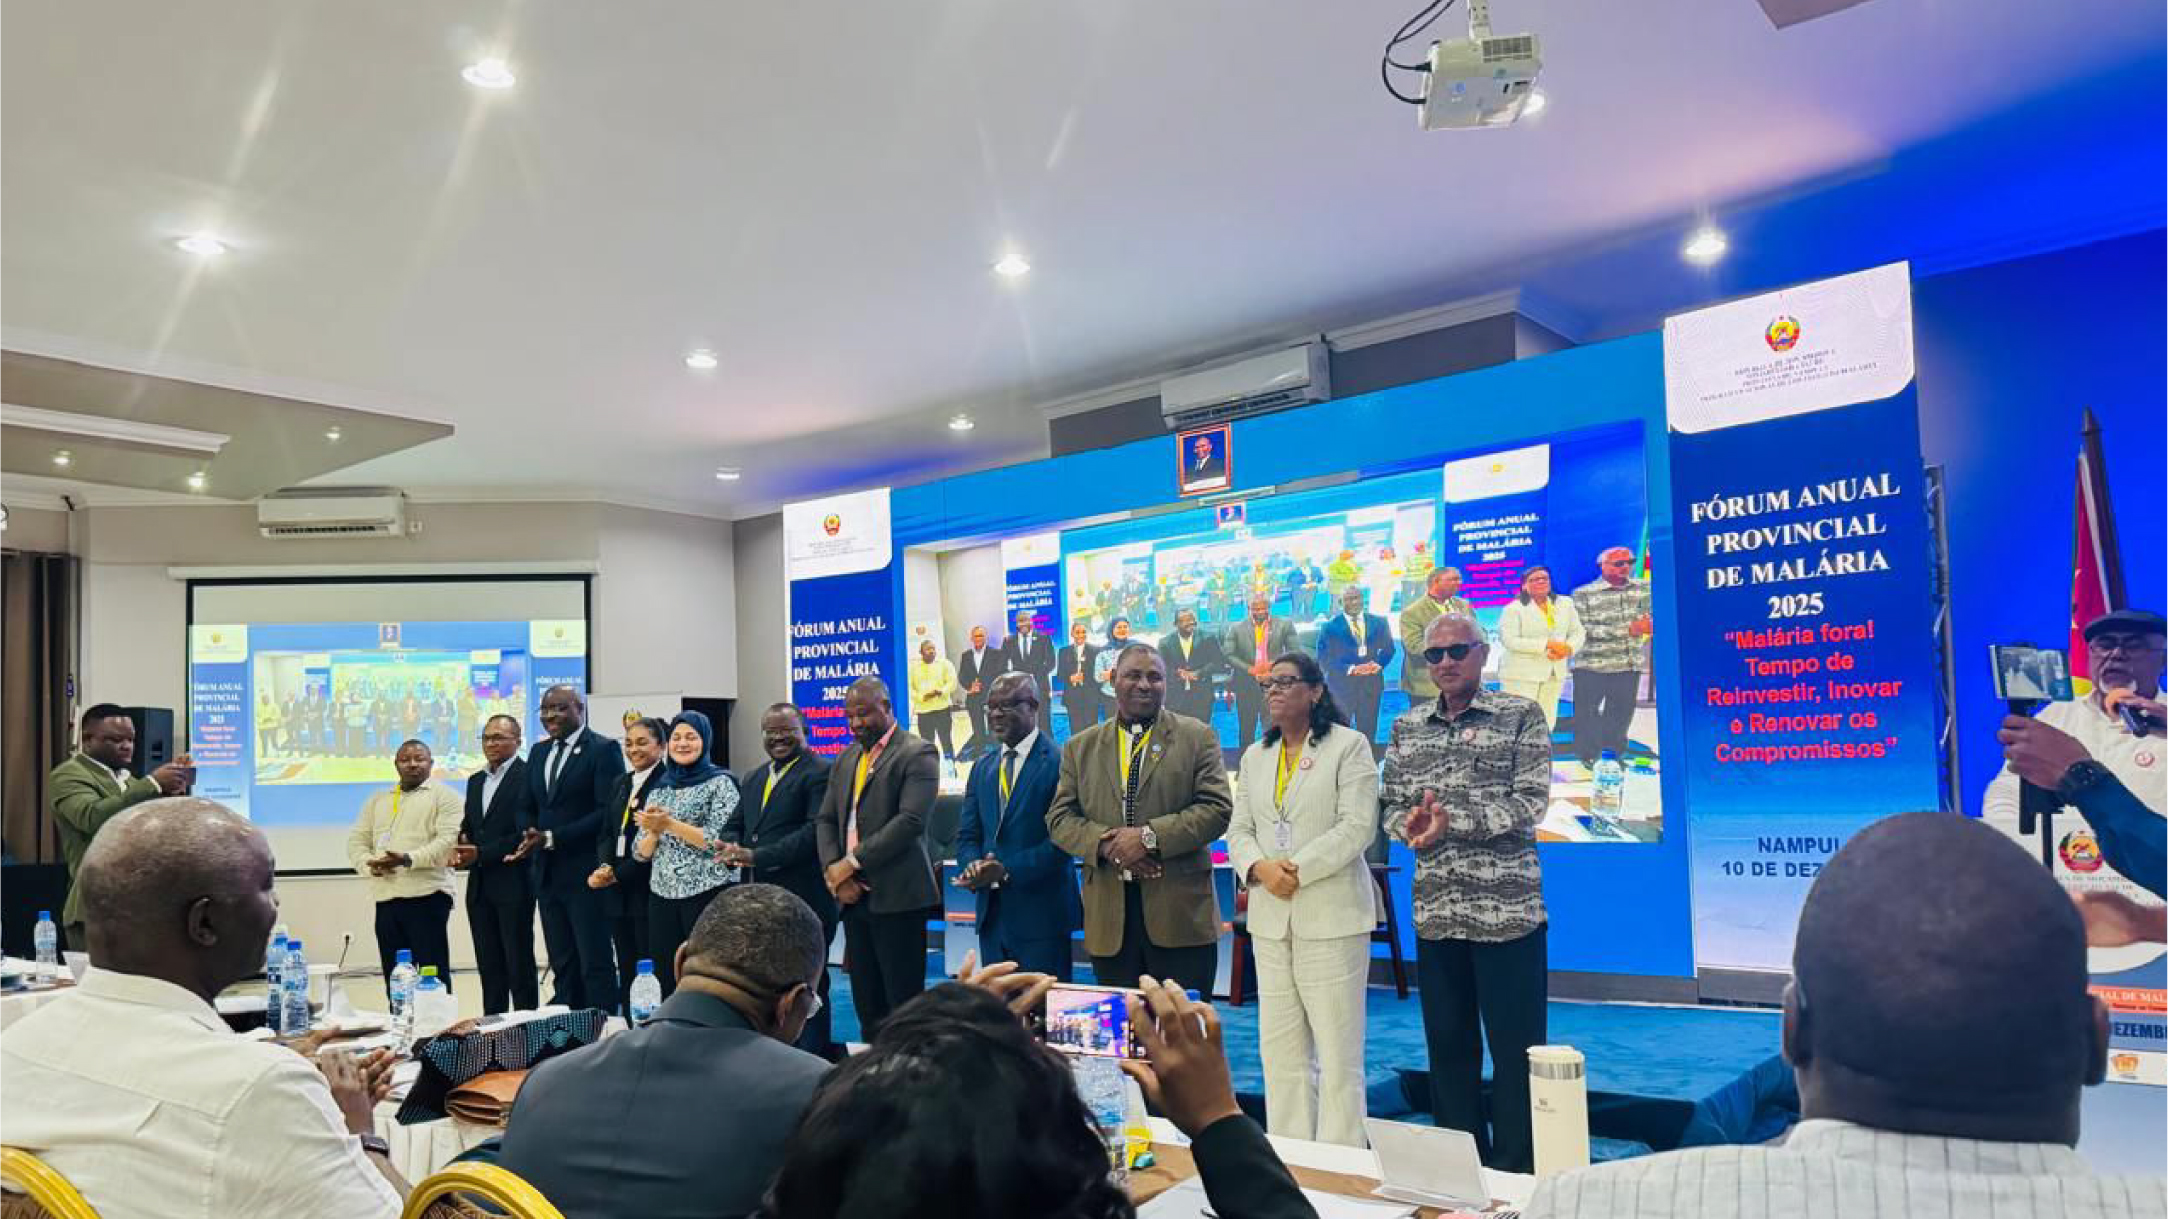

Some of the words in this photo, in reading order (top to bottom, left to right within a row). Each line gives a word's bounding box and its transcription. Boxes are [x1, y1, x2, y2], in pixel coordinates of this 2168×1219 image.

[1691, 489, 1790, 523] FÓRUM
[1796, 473, 1900, 508] ANUAL
[1707, 513, 1886, 555] PROVINCIAL
[1707, 566, 1743, 589] DE
[1751, 548, 1890, 584] MALÁRIA
[1767, 592, 1824, 618] 2025
[838, 616, 886, 633] ANUAL
[1820, 620, 1875, 643] fora!
[793, 639, 879, 659] PROVINCIAL
[794, 667, 812, 681] DE
[815, 659, 880, 680] MALÁRIA
[1745, 657, 1819, 678] Tempo
[1826, 652, 1854, 671] de
[1707, 682, 1821, 706] Reinvestir,
[1828, 680, 1902, 700] Inovar
[1730, 718, 1743, 734] e
[1749, 712, 1842, 733] Renovar
[1849, 712, 1878, 729] os
[1722, 862, 1743, 876] 10
[1751, 861, 1777, 876] DE
[1785, 862, 1823, 878] DEZ
[2112, 1021, 2167, 1039] EZEMB
